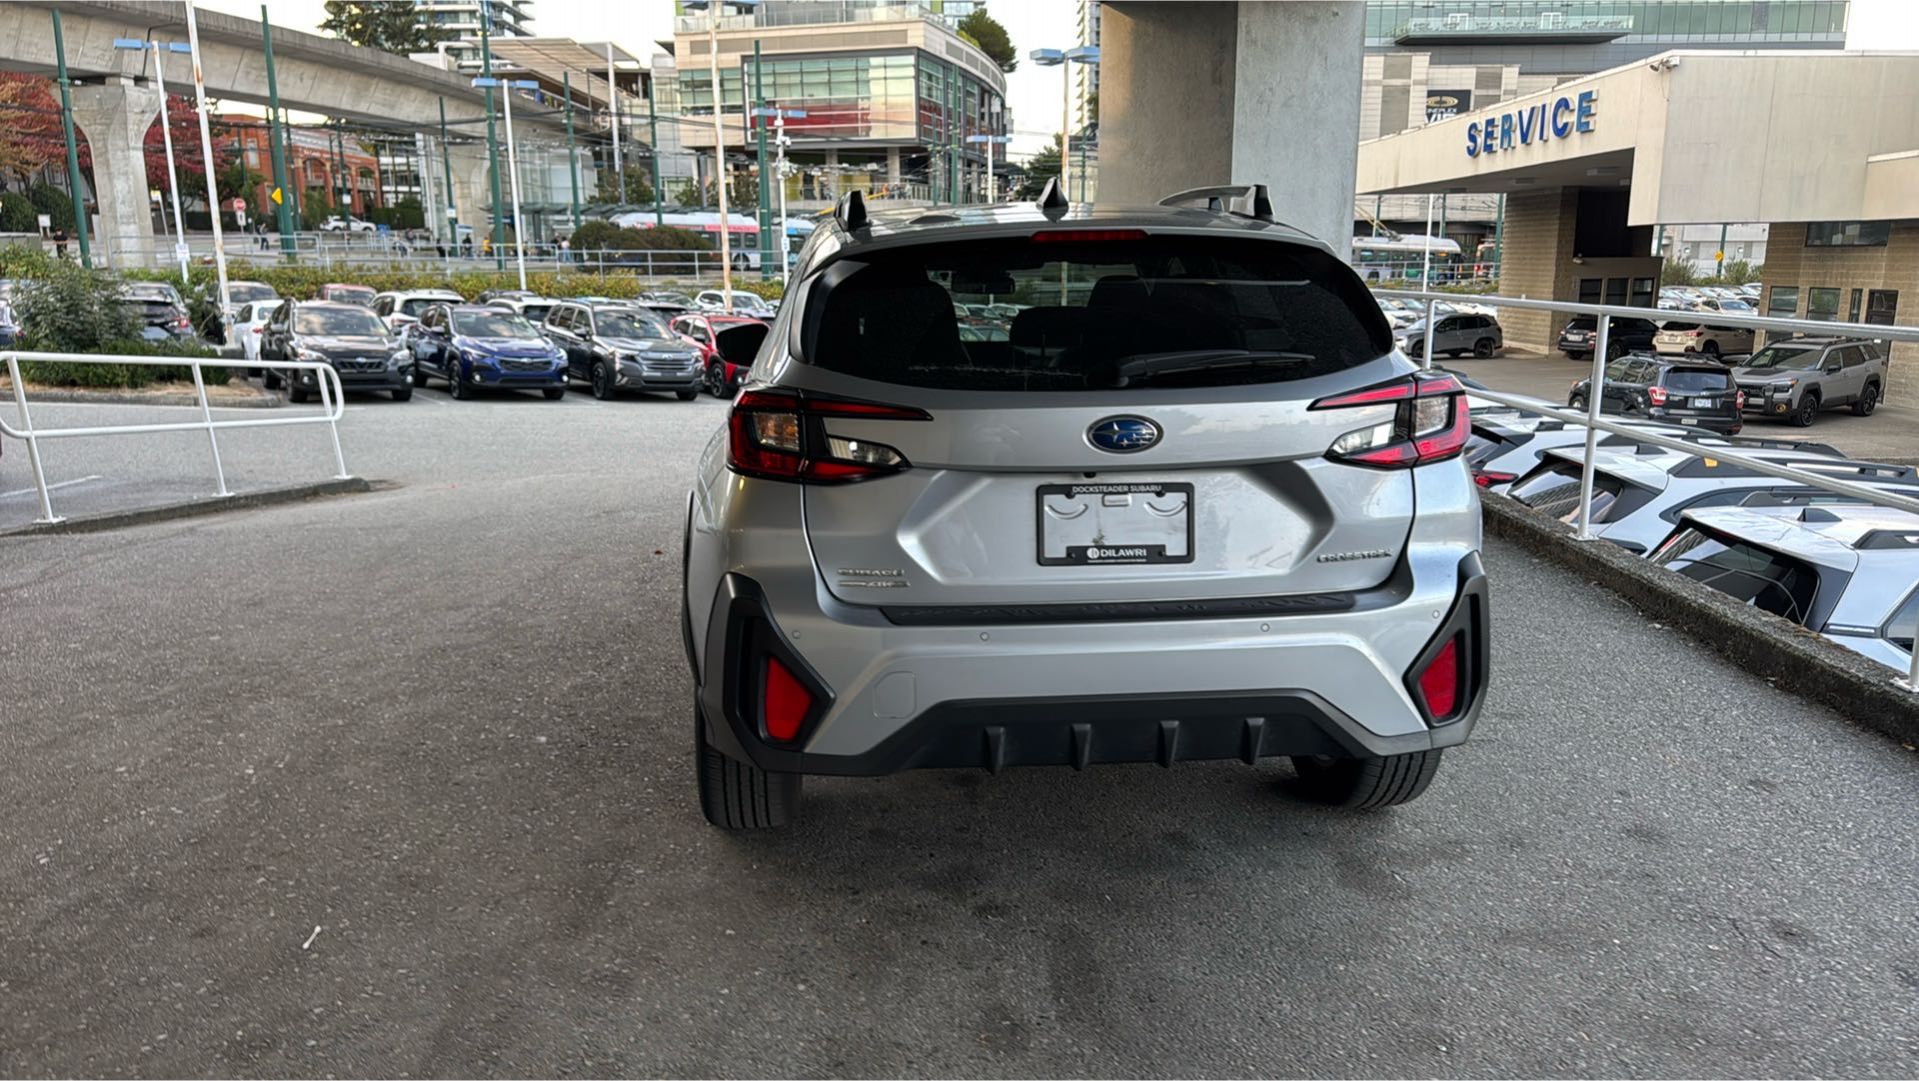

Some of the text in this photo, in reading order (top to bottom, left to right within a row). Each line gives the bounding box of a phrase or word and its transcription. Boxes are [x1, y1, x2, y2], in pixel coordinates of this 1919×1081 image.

[1466, 89, 1597, 158] SERVICE
[1072, 484, 1162, 493] DOCKSTEADER SUBARU
[1100, 548, 1147, 557] DILAWRI
